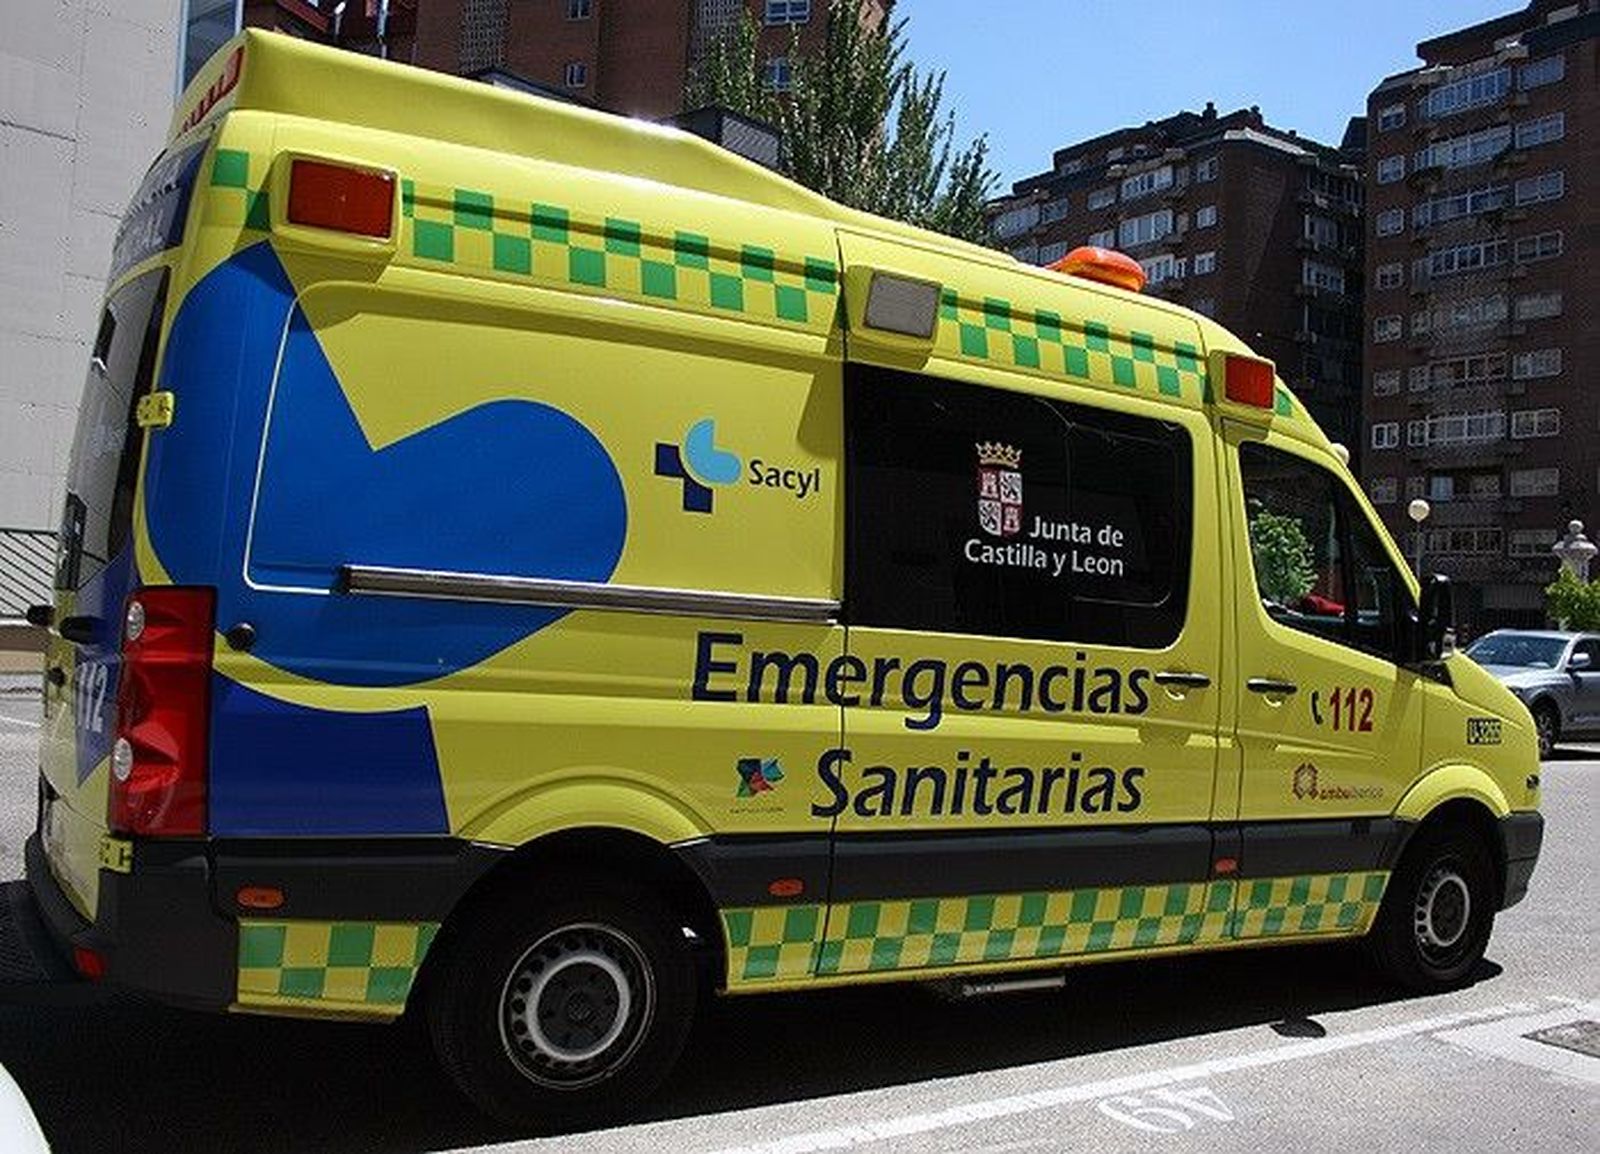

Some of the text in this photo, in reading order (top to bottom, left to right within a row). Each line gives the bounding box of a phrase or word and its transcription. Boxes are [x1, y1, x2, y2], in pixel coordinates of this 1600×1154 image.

[748, 458, 821, 499] Sacyl
[1029, 516, 1124, 547] Junta de
[964, 539, 1124, 576] Castilla y Leon
[691, 630, 1152, 731] Emergencias
[1330, 686, 1374, 732] 112
[811, 748, 1146, 818] Sanitarias
